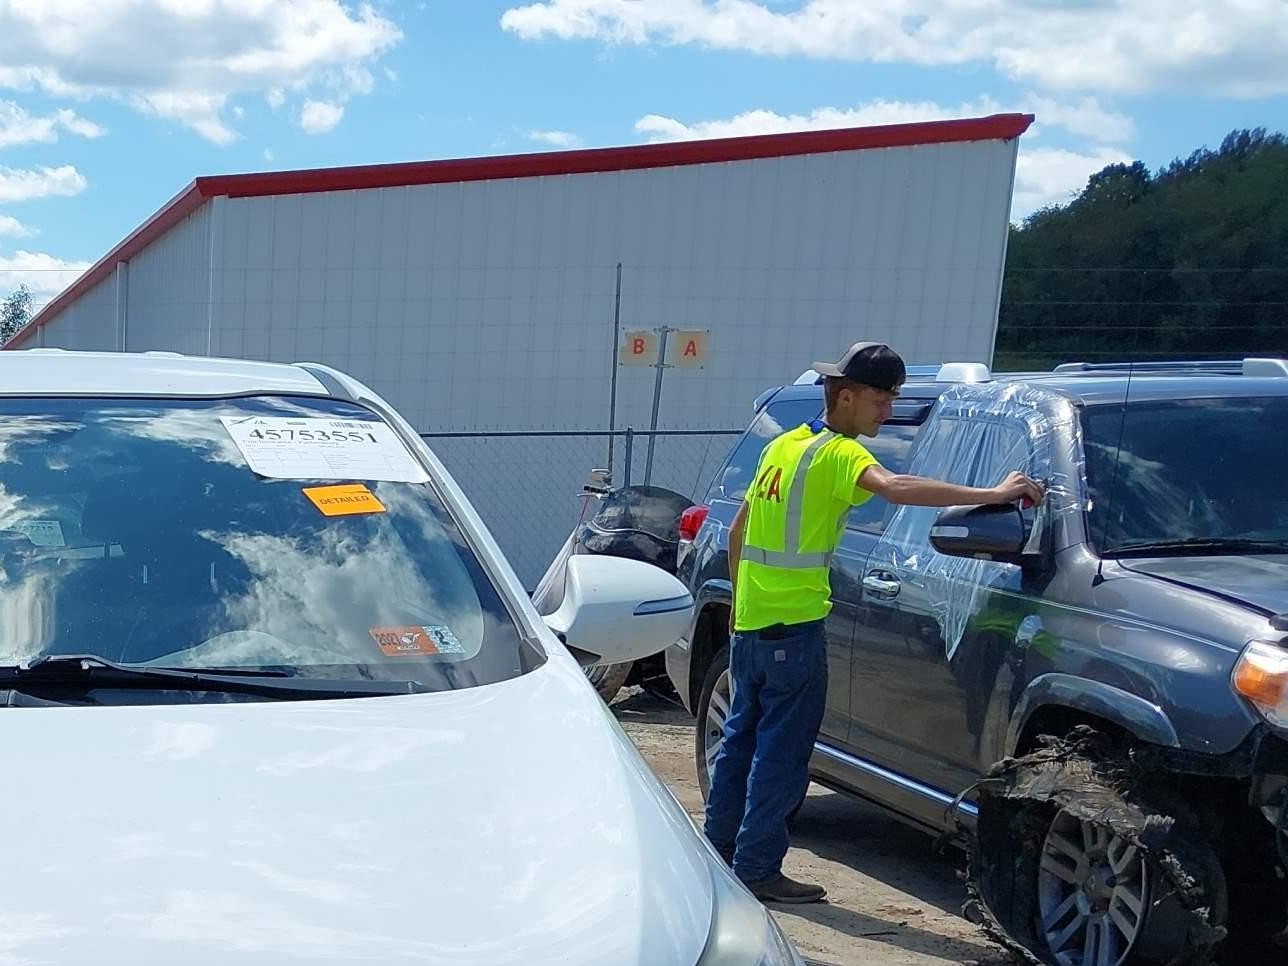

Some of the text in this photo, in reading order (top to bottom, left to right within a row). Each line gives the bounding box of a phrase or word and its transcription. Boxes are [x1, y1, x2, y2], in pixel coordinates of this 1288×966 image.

[633, 338, 645, 355] B
[683, 340, 697, 357] A
[249, 428, 379, 444] 45753551
[319, 494, 370, 505] DETAILED
